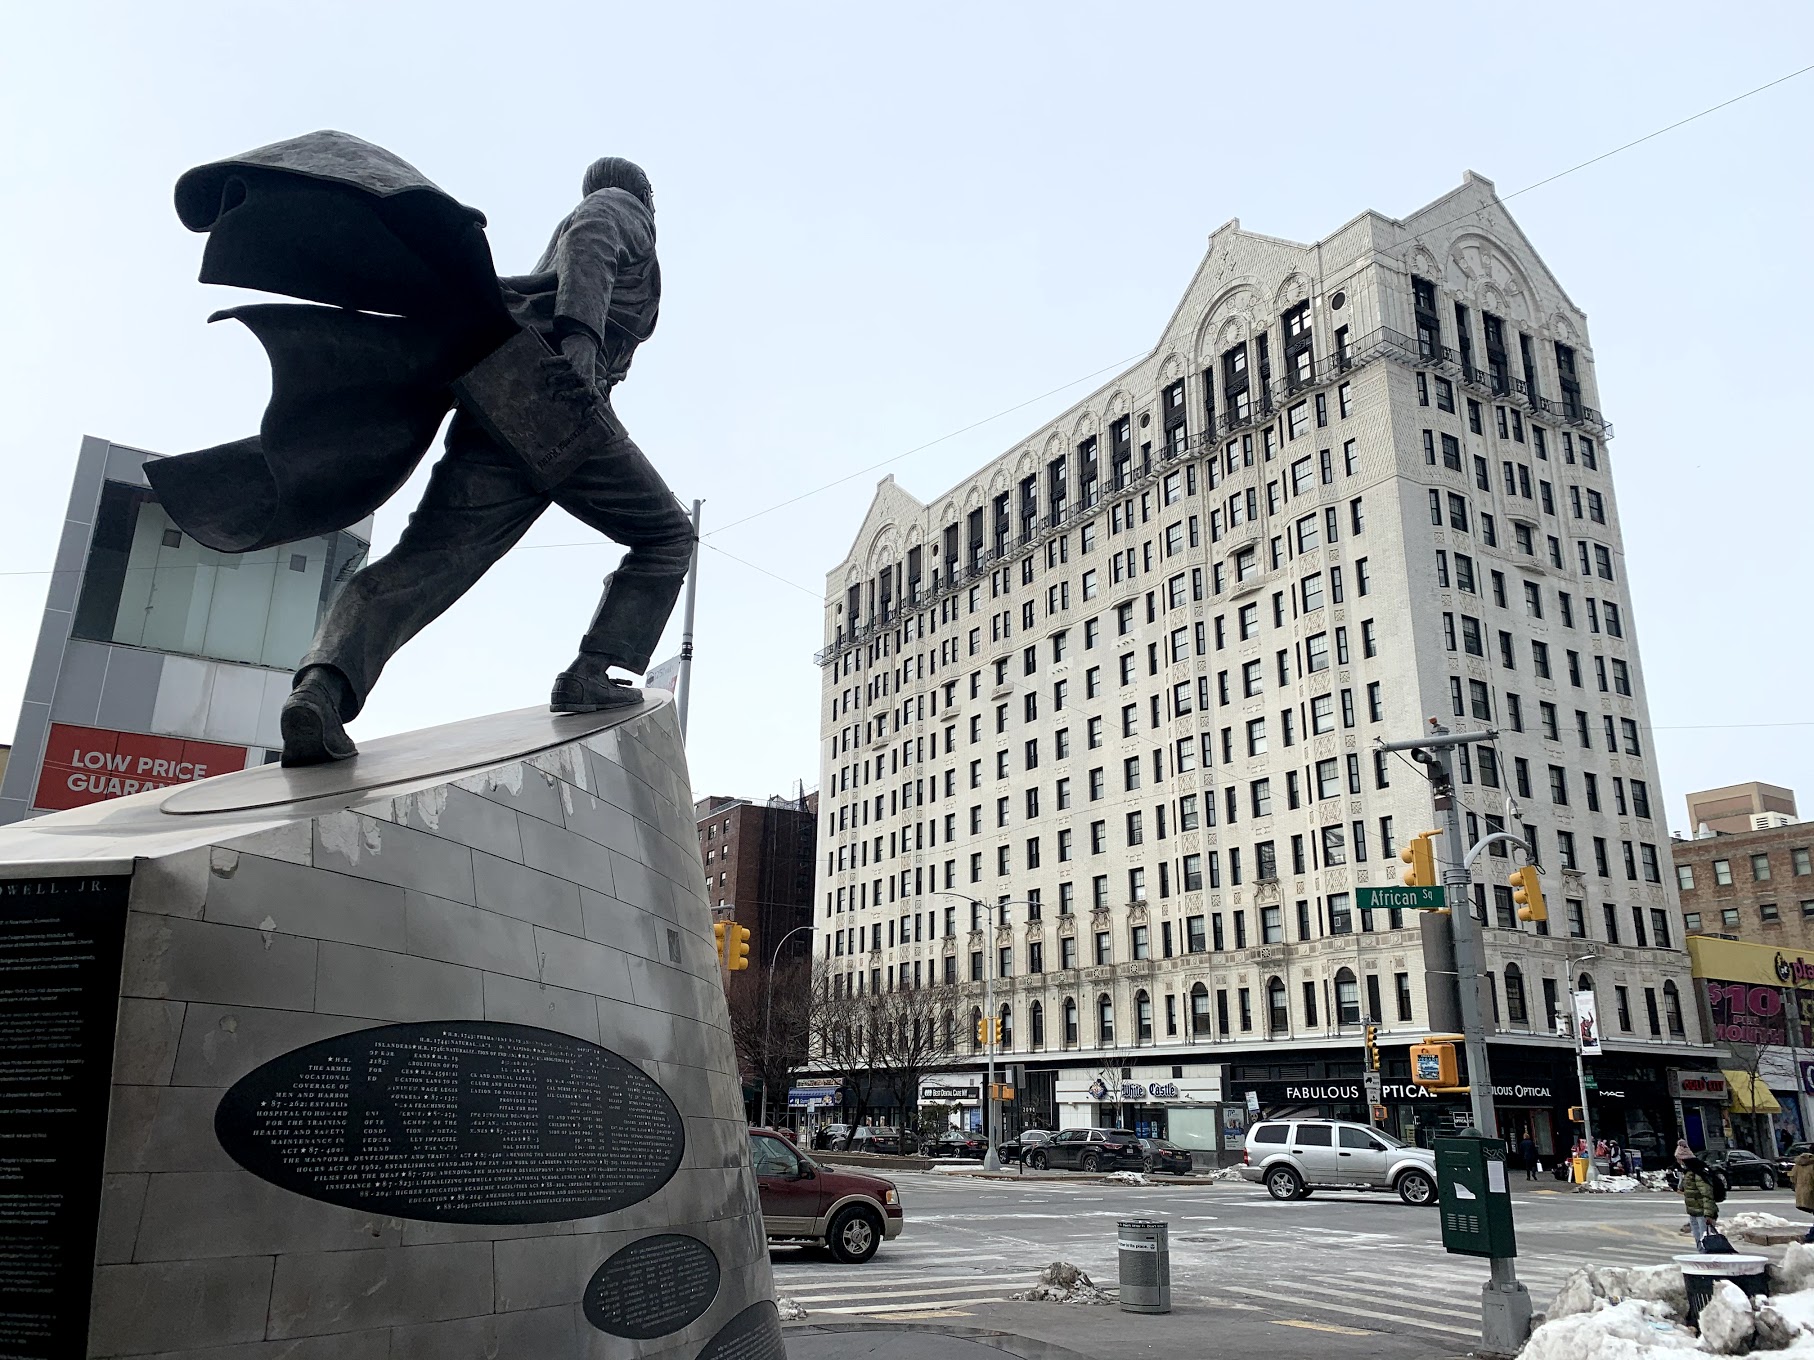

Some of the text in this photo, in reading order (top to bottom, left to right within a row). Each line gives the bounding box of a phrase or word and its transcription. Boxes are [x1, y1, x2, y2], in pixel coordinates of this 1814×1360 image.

[71, 749, 208, 780] LOW PRICE
[78, 880, 107, 892] JR.
[1371, 889, 1433, 906] African Sq
[1707, 982, 1781, 1017] $10
[1732, 1015, 1760, 1026] PER
[1121, 1083, 1177, 1099] White Castle
[1286, 1085, 1438, 1099] FABULOUS PTICAL
[1514, 1085, 1552, 1097] OPTICAL
[325, 1182, 372, 1190] INSURANCE
